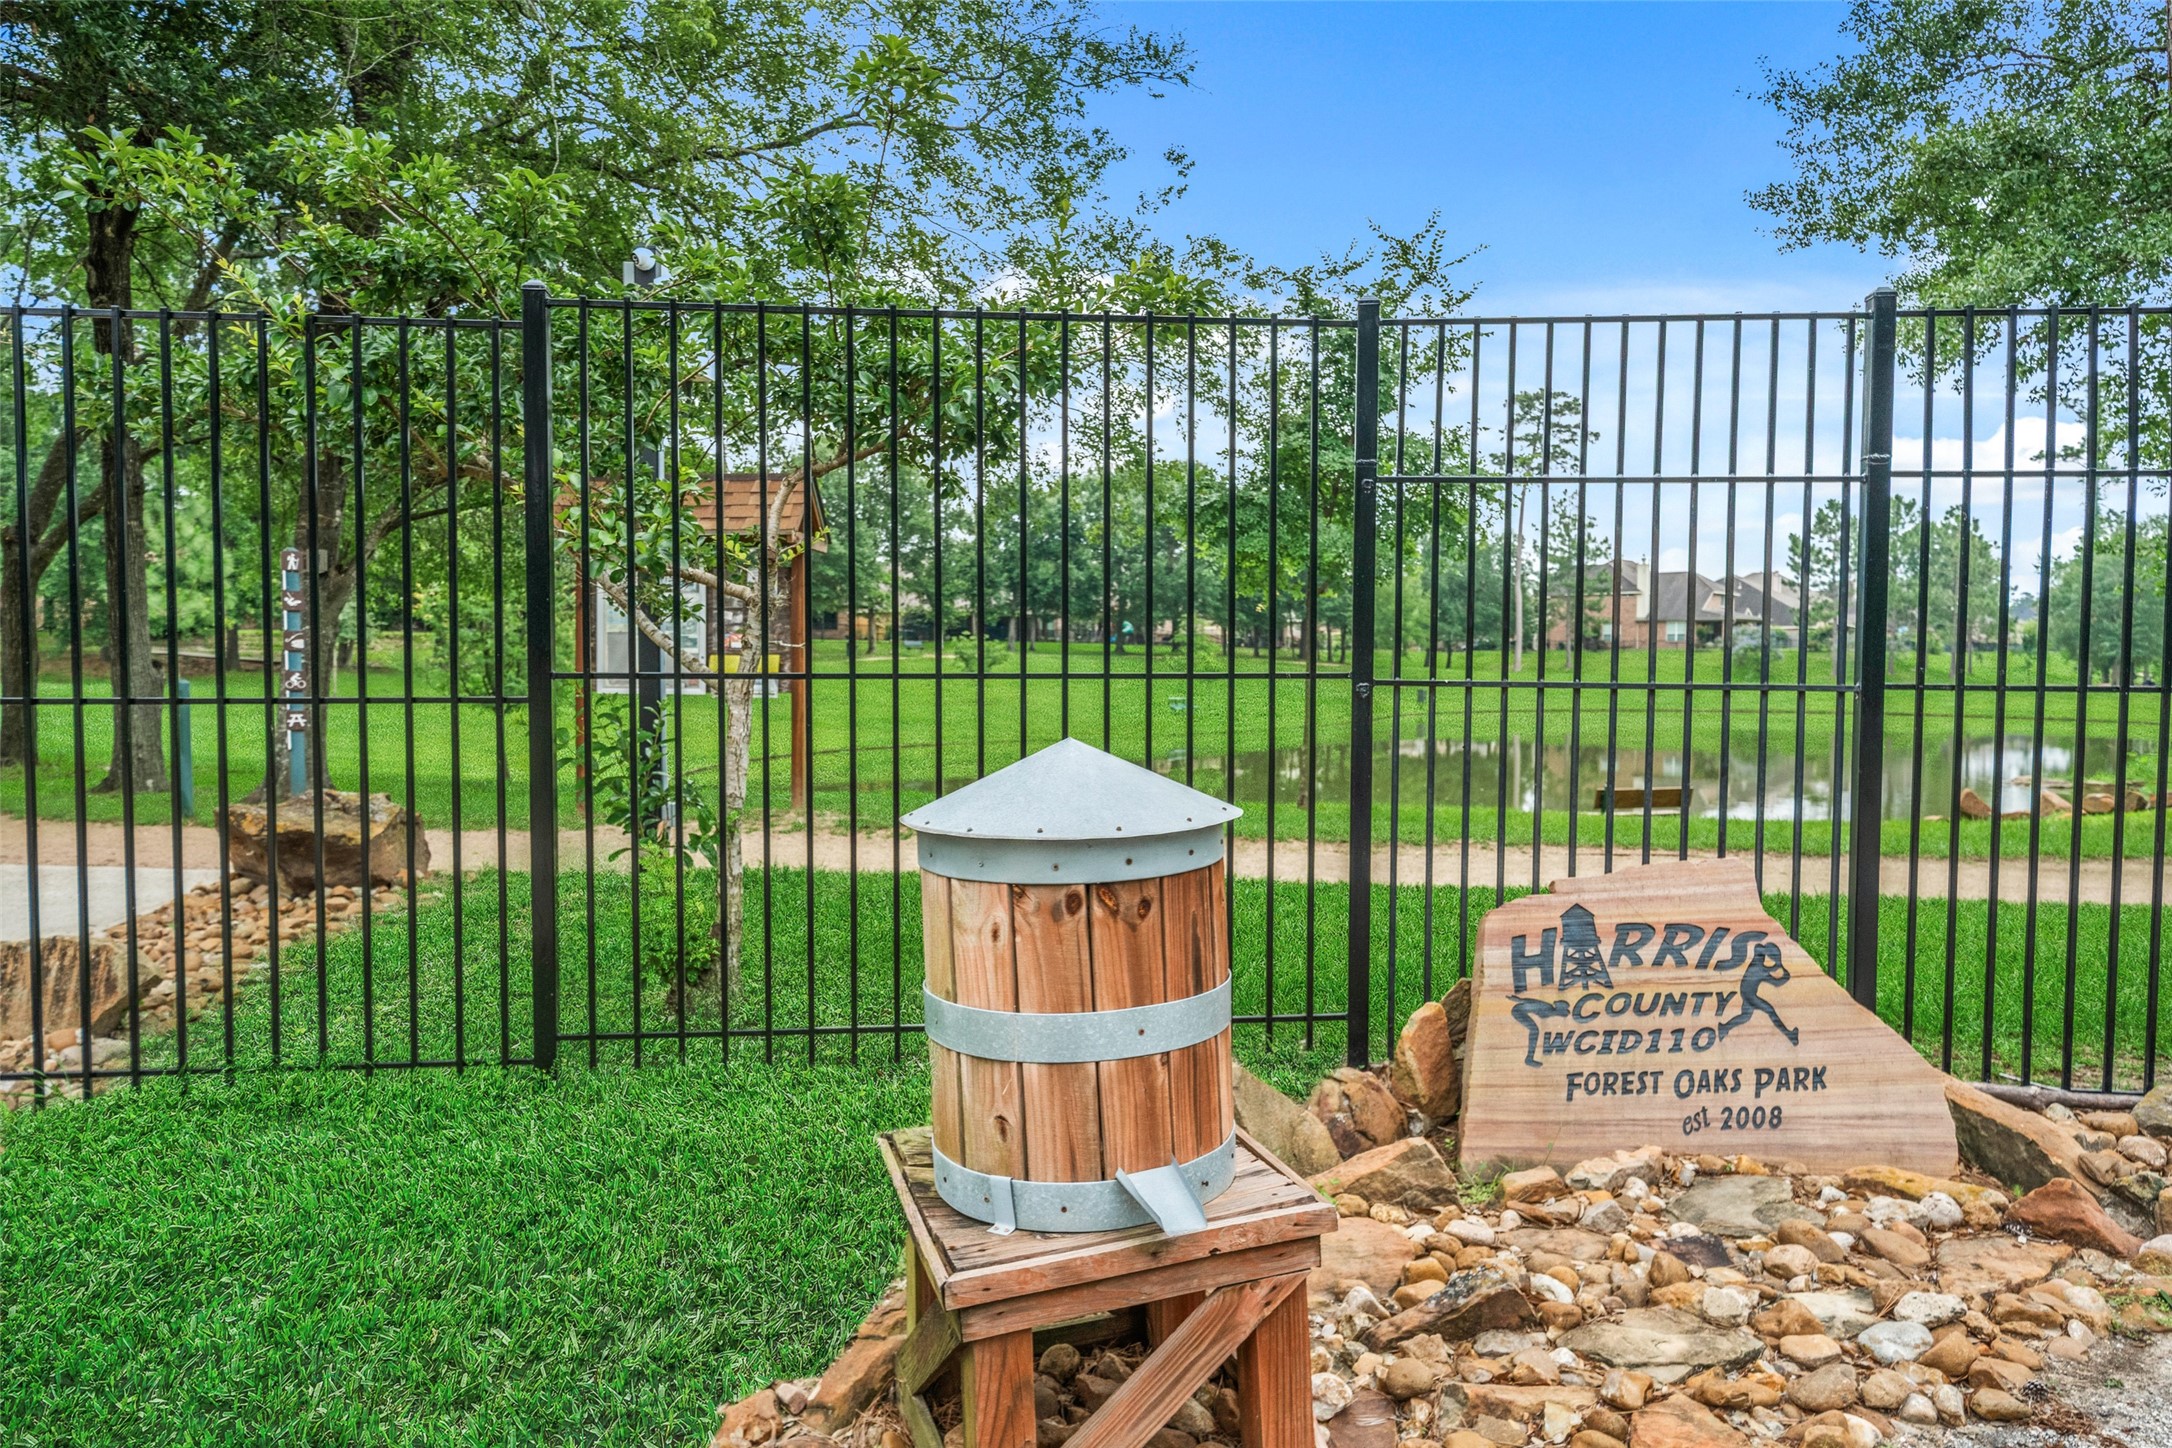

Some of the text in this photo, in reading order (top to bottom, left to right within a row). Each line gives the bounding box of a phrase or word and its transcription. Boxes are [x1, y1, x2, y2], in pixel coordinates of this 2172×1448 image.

[1510, 903, 1768, 993] HARRIS
[1571, 991, 1738, 1023] COUNTY
[1566, 1065, 1828, 1102] FOREST OAKS PARK
[1682, 1105, 1784, 1136] est 2008
